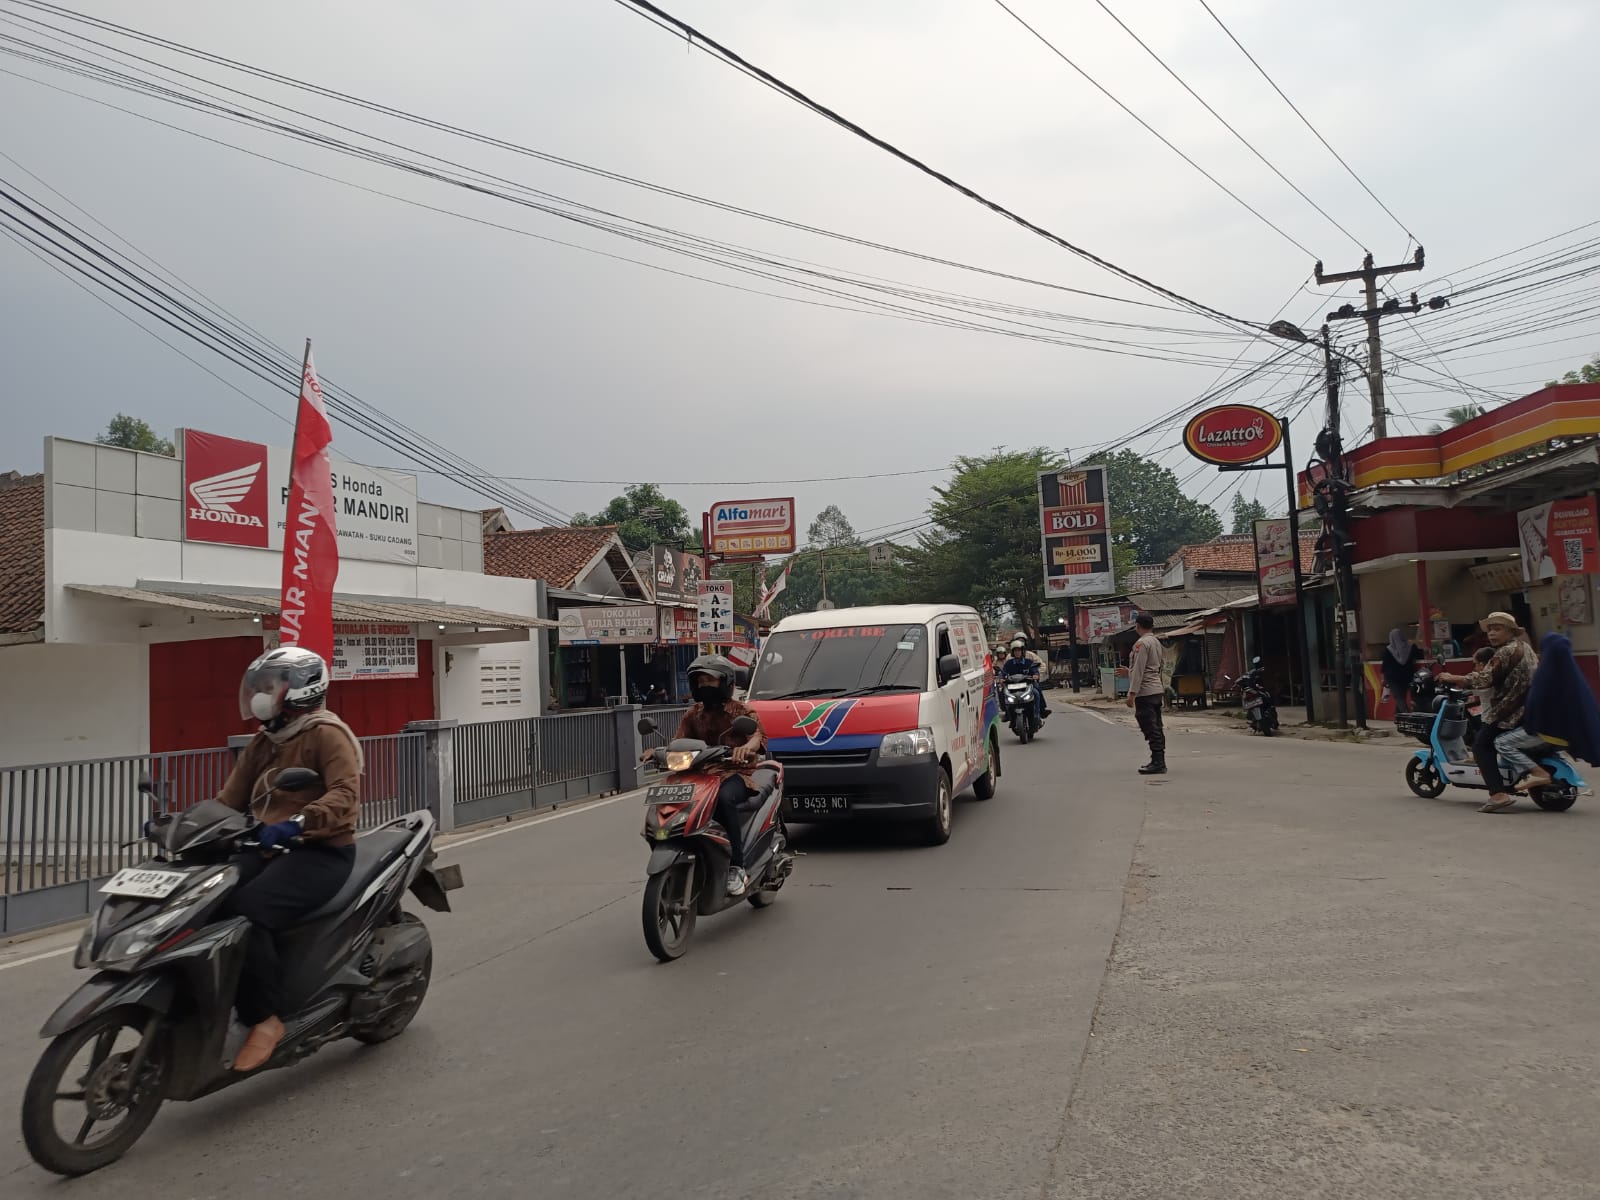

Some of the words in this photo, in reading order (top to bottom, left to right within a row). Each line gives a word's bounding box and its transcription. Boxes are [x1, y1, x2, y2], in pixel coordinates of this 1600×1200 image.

[1199, 425, 1256, 442] Lazatto
[343, 475, 382, 496] Honda
[190, 507, 264, 527] HONDA
[344, 497, 409, 524] MANDIRI
[717, 505, 786, 521] Alfamart
[1052, 513, 1098, 530] BOLD
[292, 494, 321, 580] MAN
[370, 533, 386, 541] SUKU
[387, 535, 412, 546] CADANG
[602, 610, 624, 618] TOKO
[628, 609, 641, 617] AKI
[615, 618, 655, 628] BATTERY
[793, 797, 799, 808] B
[804, 797, 827, 808] 9453
